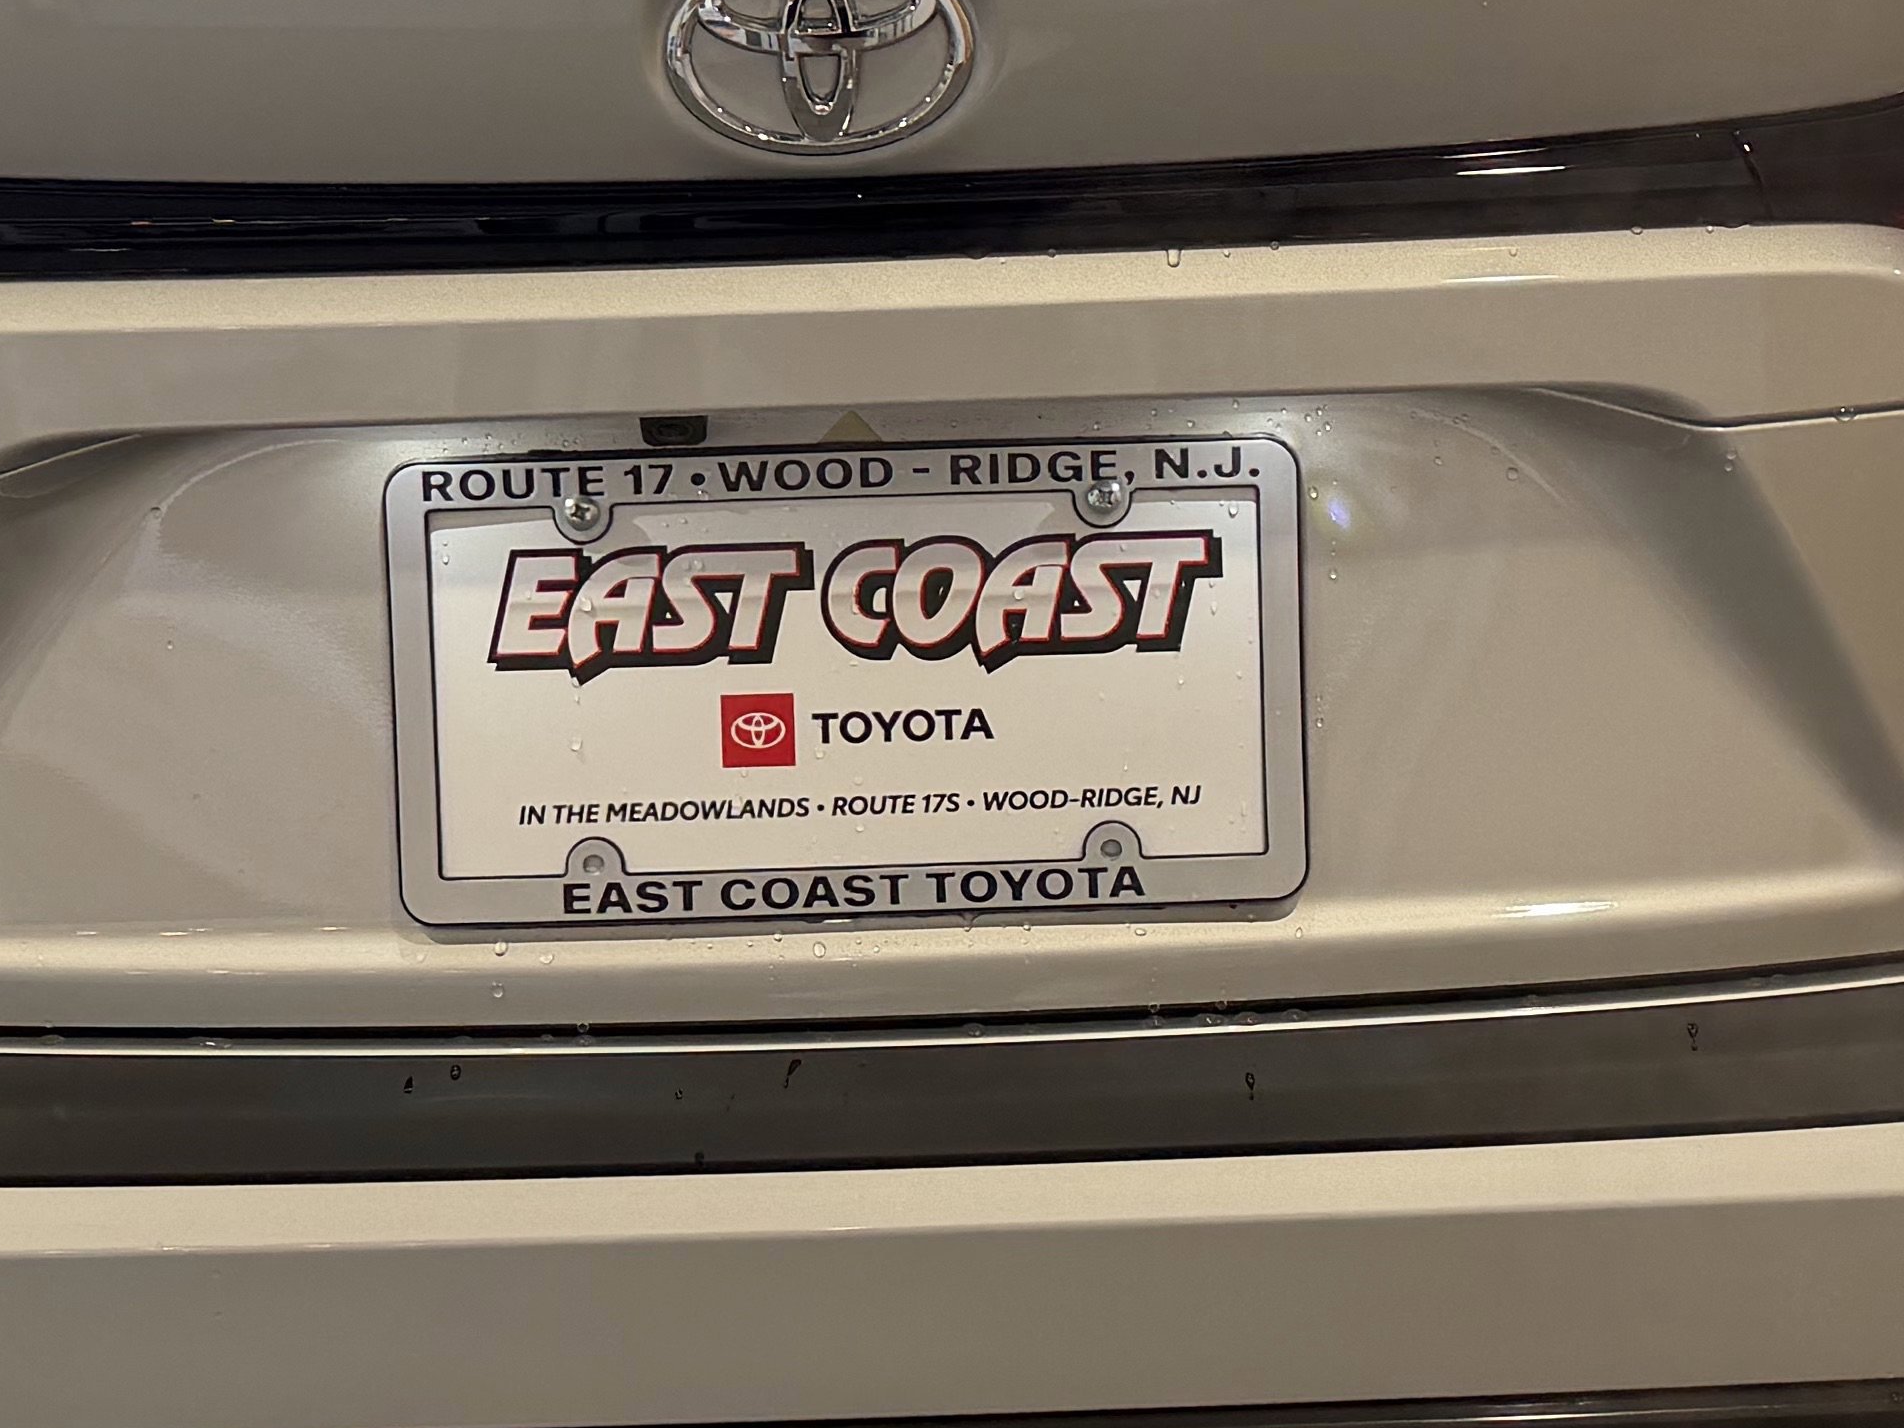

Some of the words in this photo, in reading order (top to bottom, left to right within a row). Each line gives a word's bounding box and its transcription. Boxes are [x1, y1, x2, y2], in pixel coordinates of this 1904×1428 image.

[422, 465, 604, 502] ROUTE
[624, 463, 674, 496] 17
[718, 456, 893, 493] WOOD
[950, 449, 1135, 486] RIDGE,
[1155, 446, 1261, 480] N.J.
[487, 542, 815, 687] EAST
[820, 529, 1223, 675] COAST
[811, 708, 995, 745] TOYOTA
[519, 804, 546, 826] IN
[552, 802, 600, 824] THE
[605, 797, 810, 824] MEADOWLANDS
[832, 794, 916, 816] ROUTE
[922, 793, 961, 814] 17S
[983, 785, 1164, 812] WOOD-RIDGE,
[1171, 784, 1202, 805] NJ
[562, 879, 703, 915] EAST
[721, 874, 910, 910] COAST
[925, 865, 1146, 904] TOYOTA
